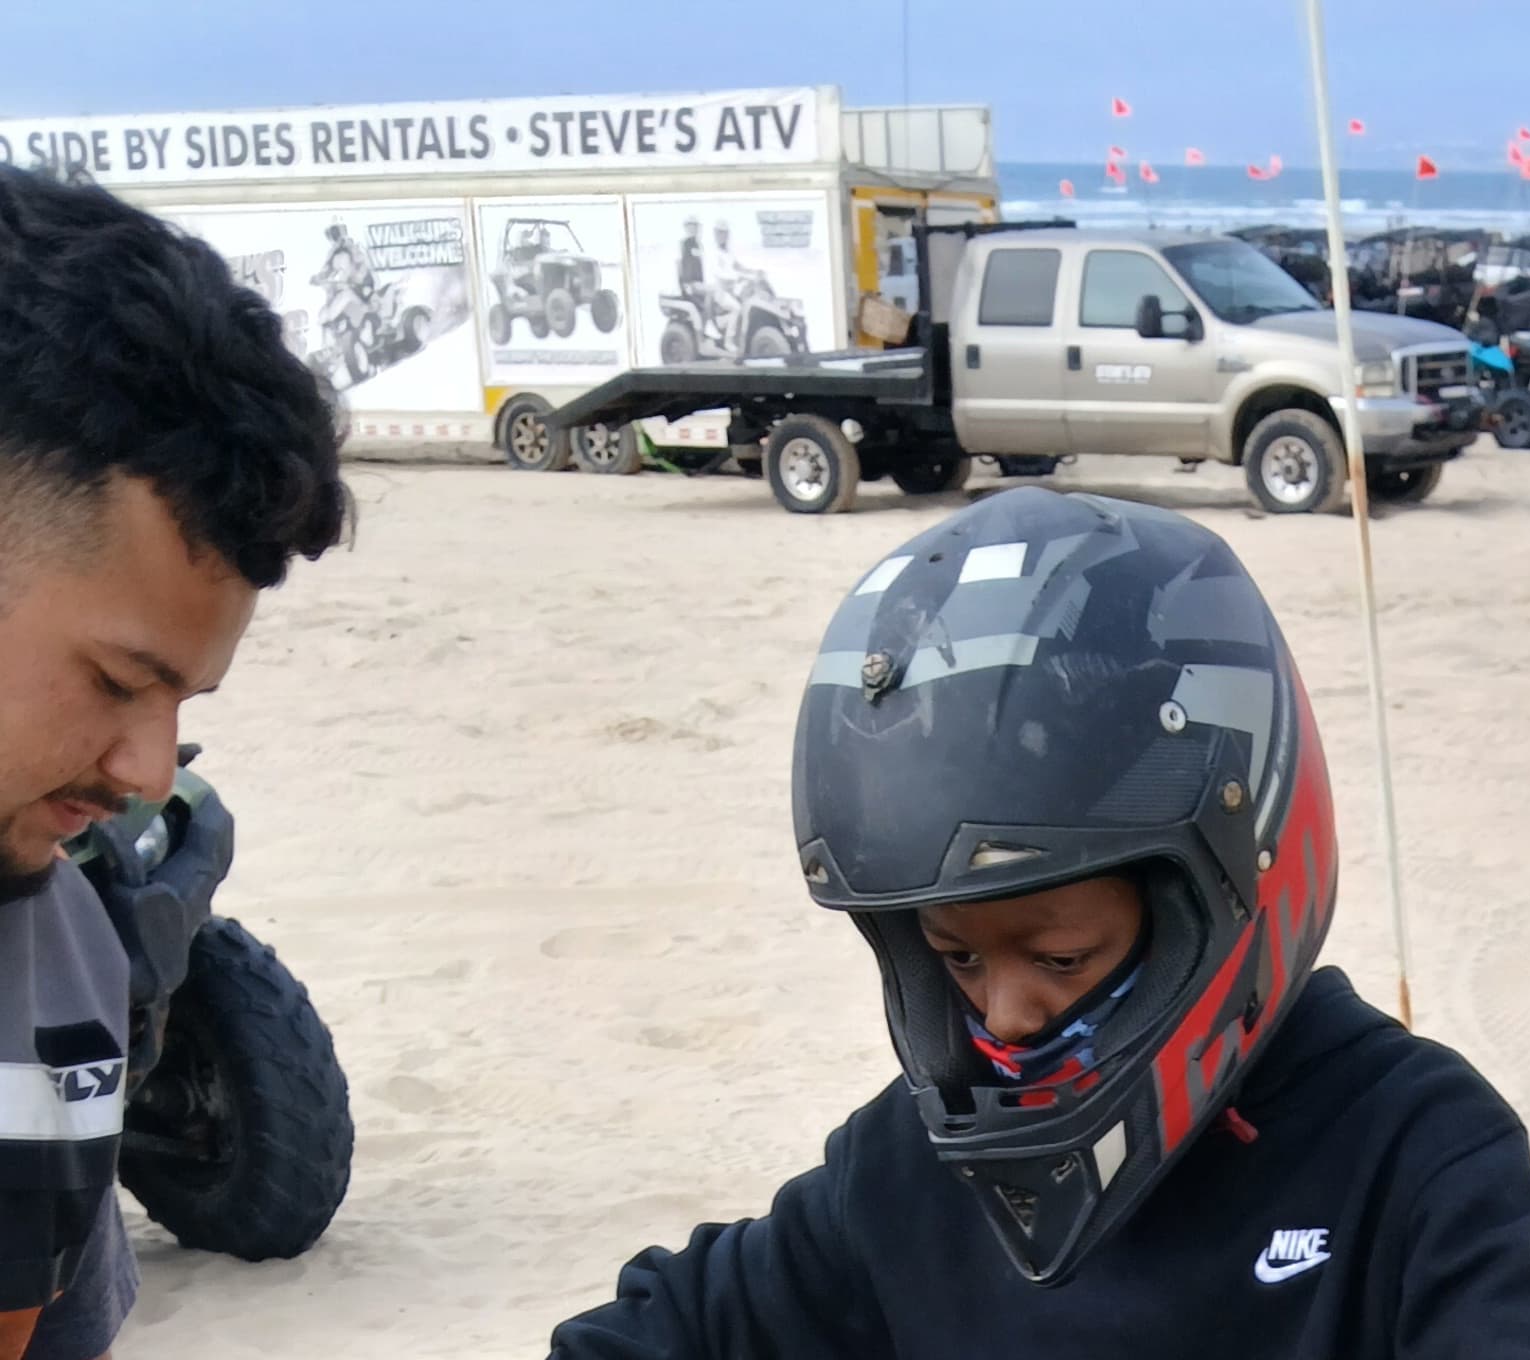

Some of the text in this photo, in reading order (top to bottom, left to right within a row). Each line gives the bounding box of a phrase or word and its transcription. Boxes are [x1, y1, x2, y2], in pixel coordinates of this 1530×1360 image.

[27, 131, 111, 172] SIDE
[124, 128, 171, 170] BY
[185, 122, 295, 168] SIDES
[310, 114, 490, 164] RENTALS
[529, 107, 697, 157] STEVE'S
[713, 104, 802, 151] ATV
[1268, 1228, 1330, 1261] NIKE
